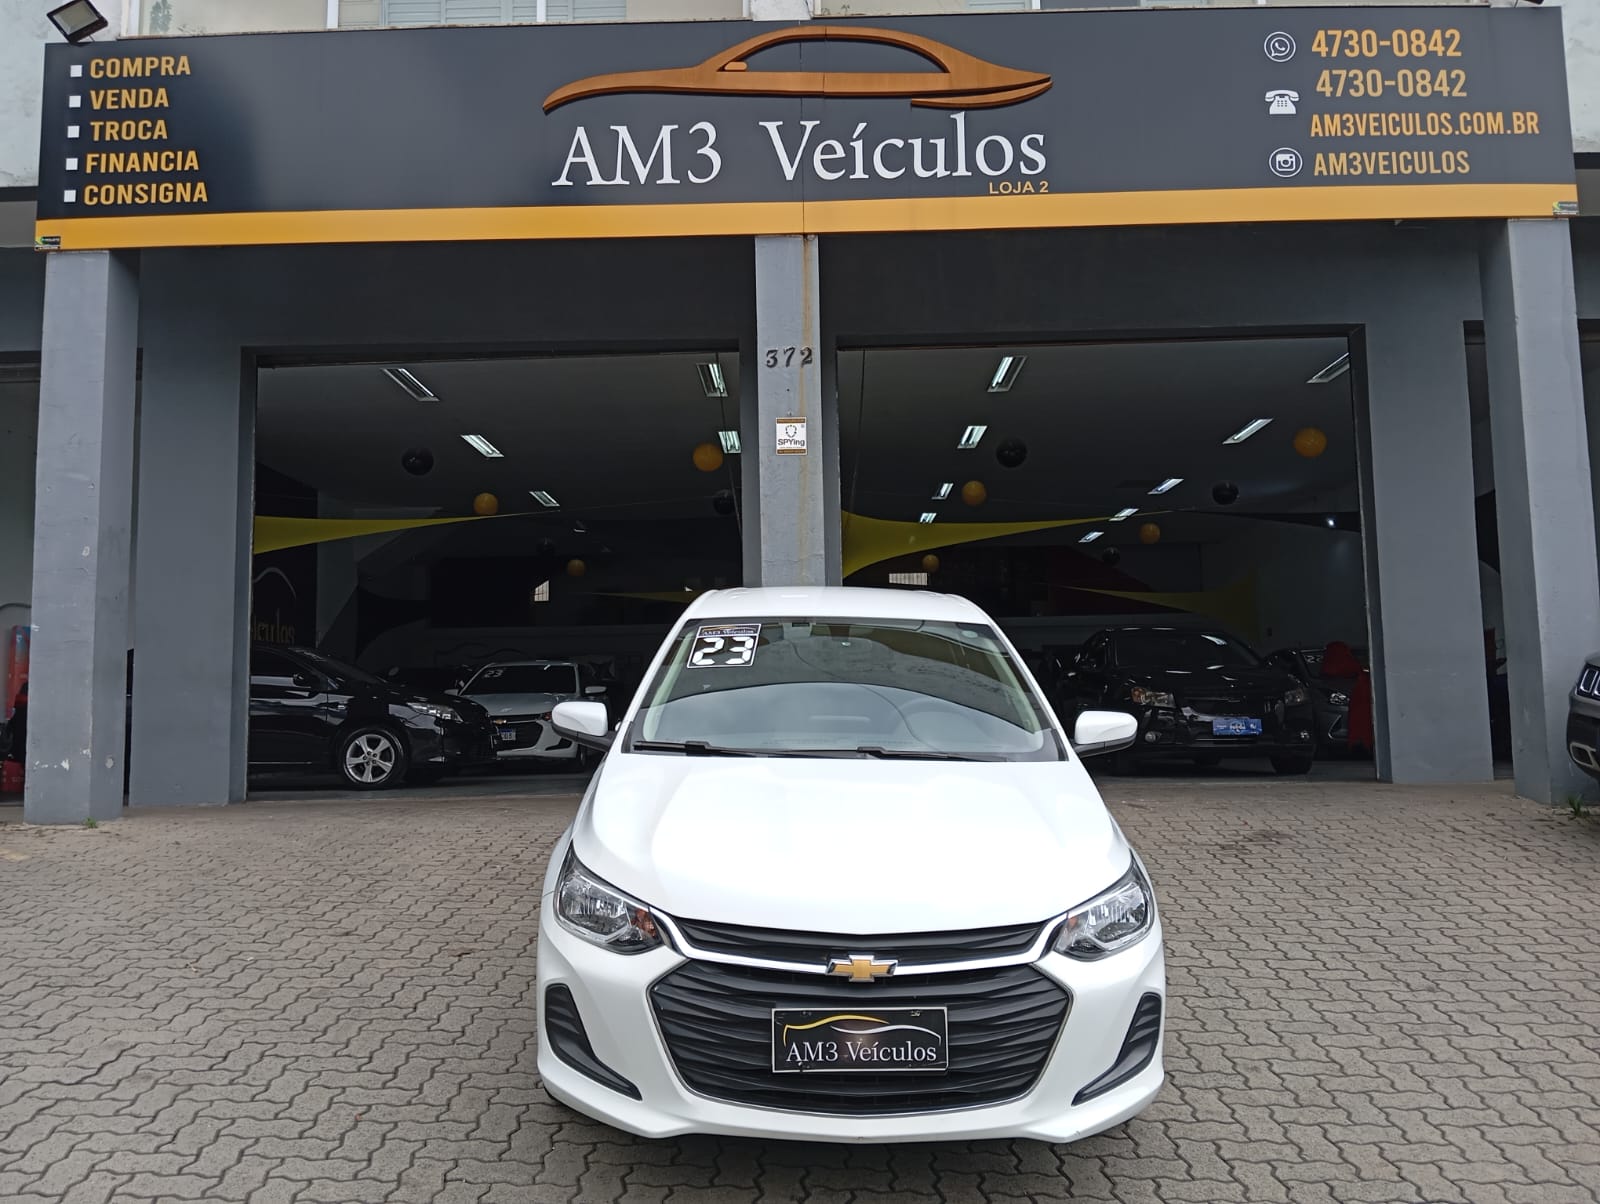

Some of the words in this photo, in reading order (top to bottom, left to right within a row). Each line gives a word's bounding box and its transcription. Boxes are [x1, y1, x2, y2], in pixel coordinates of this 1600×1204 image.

[1311, 28, 1462, 58] 4730-0842
[89, 55, 191, 79] COMPRA
[1315, 68, 1467, 97] 4730-0842
[89, 87, 170, 110] VENDA
[90, 119, 169, 141] TROCA
[1310, 111, 1540, 137] AM3VEICULOS.COM.BR
[551, 121, 722, 186] AM3
[758, 111, 1048, 181] Veículos
[84, 149, 200, 174] FINANCIA
[1313, 150, 1470, 176] AM3VEICULOS
[82, 181, 209, 206] CONSIGNA
[988, 181, 1035, 195] LOJA
[1038, 180, 1049, 193] 2
[765, 346, 813, 369] 372
[692, 637, 754, 665] 23
[785, 1041, 839, 1062] AM3
[845, 1040, 938, 1062] Veículos
